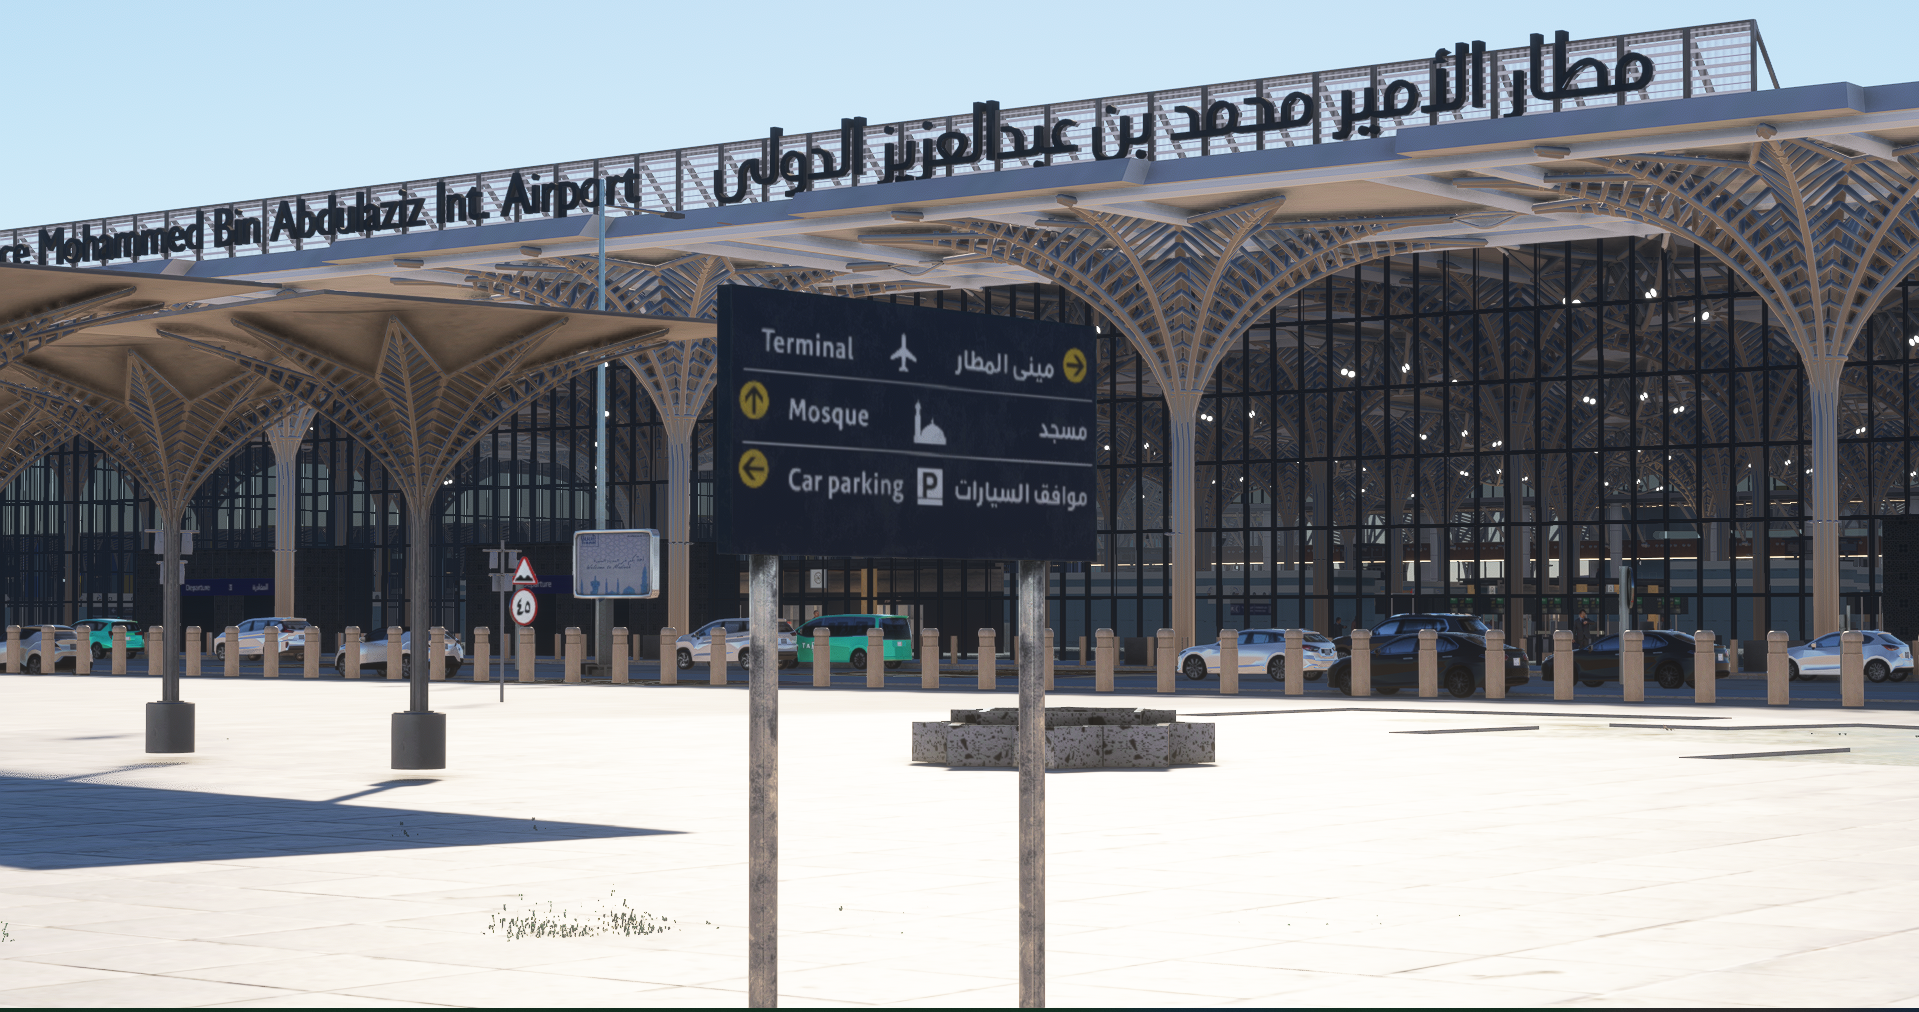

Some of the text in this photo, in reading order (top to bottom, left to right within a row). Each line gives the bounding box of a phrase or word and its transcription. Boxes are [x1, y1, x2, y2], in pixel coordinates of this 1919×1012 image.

[1332, 39, 1487, 140] الأمير
[1504, 28, 1655, 118] مطار
[1092, 104, 1153, 161] بن
[1170, 90, 1314, 141] محمد
[38, 210, 204, 265] Mohammed
[214, 208, 262, 248] Bin
[270, 188, 427, 242] Abdulaziz
[436, 182, 490, 223] Int.
[500, 167, 641, 218] Airport
[761, 327, 855, 362] Terminal
[954, 349, 1008, 376] المطار
[789, 397, 870, 432] Mosque
[1038, 422, 1088, 446] مسجد
[788, 466, 823, 494] Car
[828, 470, 905, 505] parking
[954, 479, 1088, 512] موافق السيارات
[516, 597, 531, 617] ٤٥
